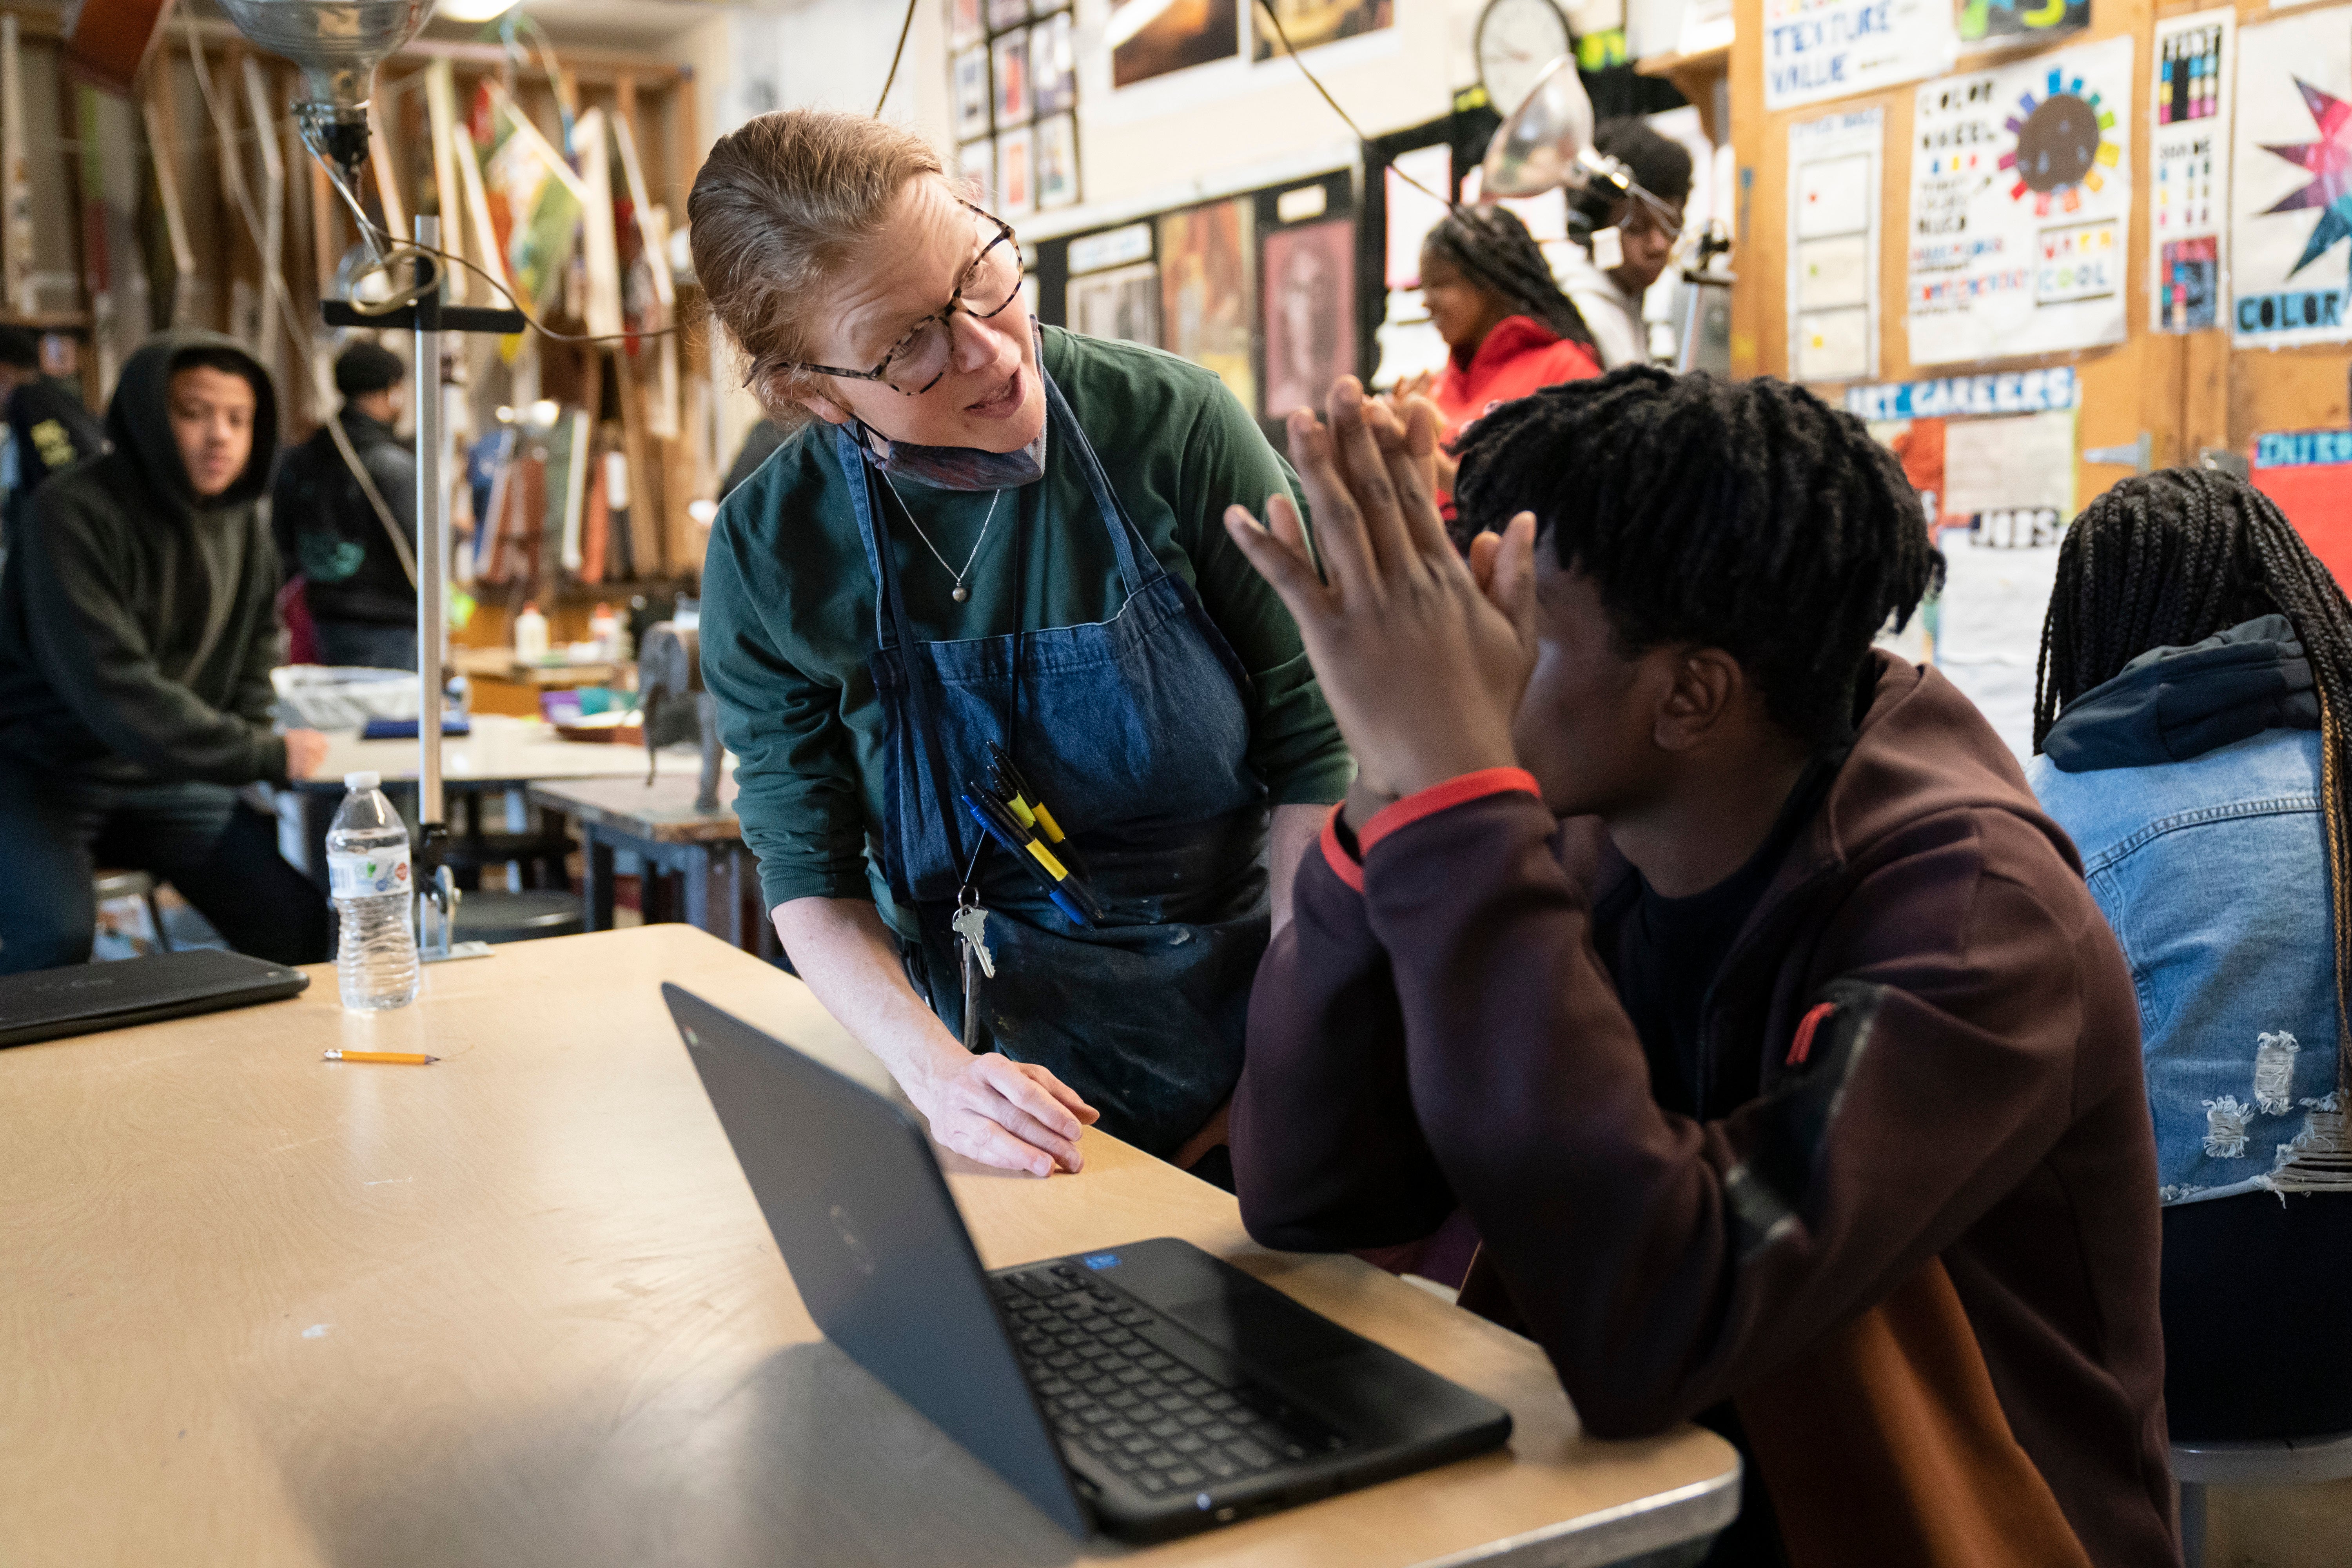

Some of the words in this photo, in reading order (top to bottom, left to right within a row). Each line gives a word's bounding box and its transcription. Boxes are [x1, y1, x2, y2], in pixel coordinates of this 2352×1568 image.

[1771, 0, 1892, 56] TEXTURE
[1771, 52, 1848, 94] VALUE
[1921, 80, 1994, 118] COLOR
[2038, 261, 2107, 292] COOL
[2239, 292, 2340, 330] COLOR
[1910, 368, 2071, 416] CAREERS
[1972, 510, 2056, 546] JOBS
